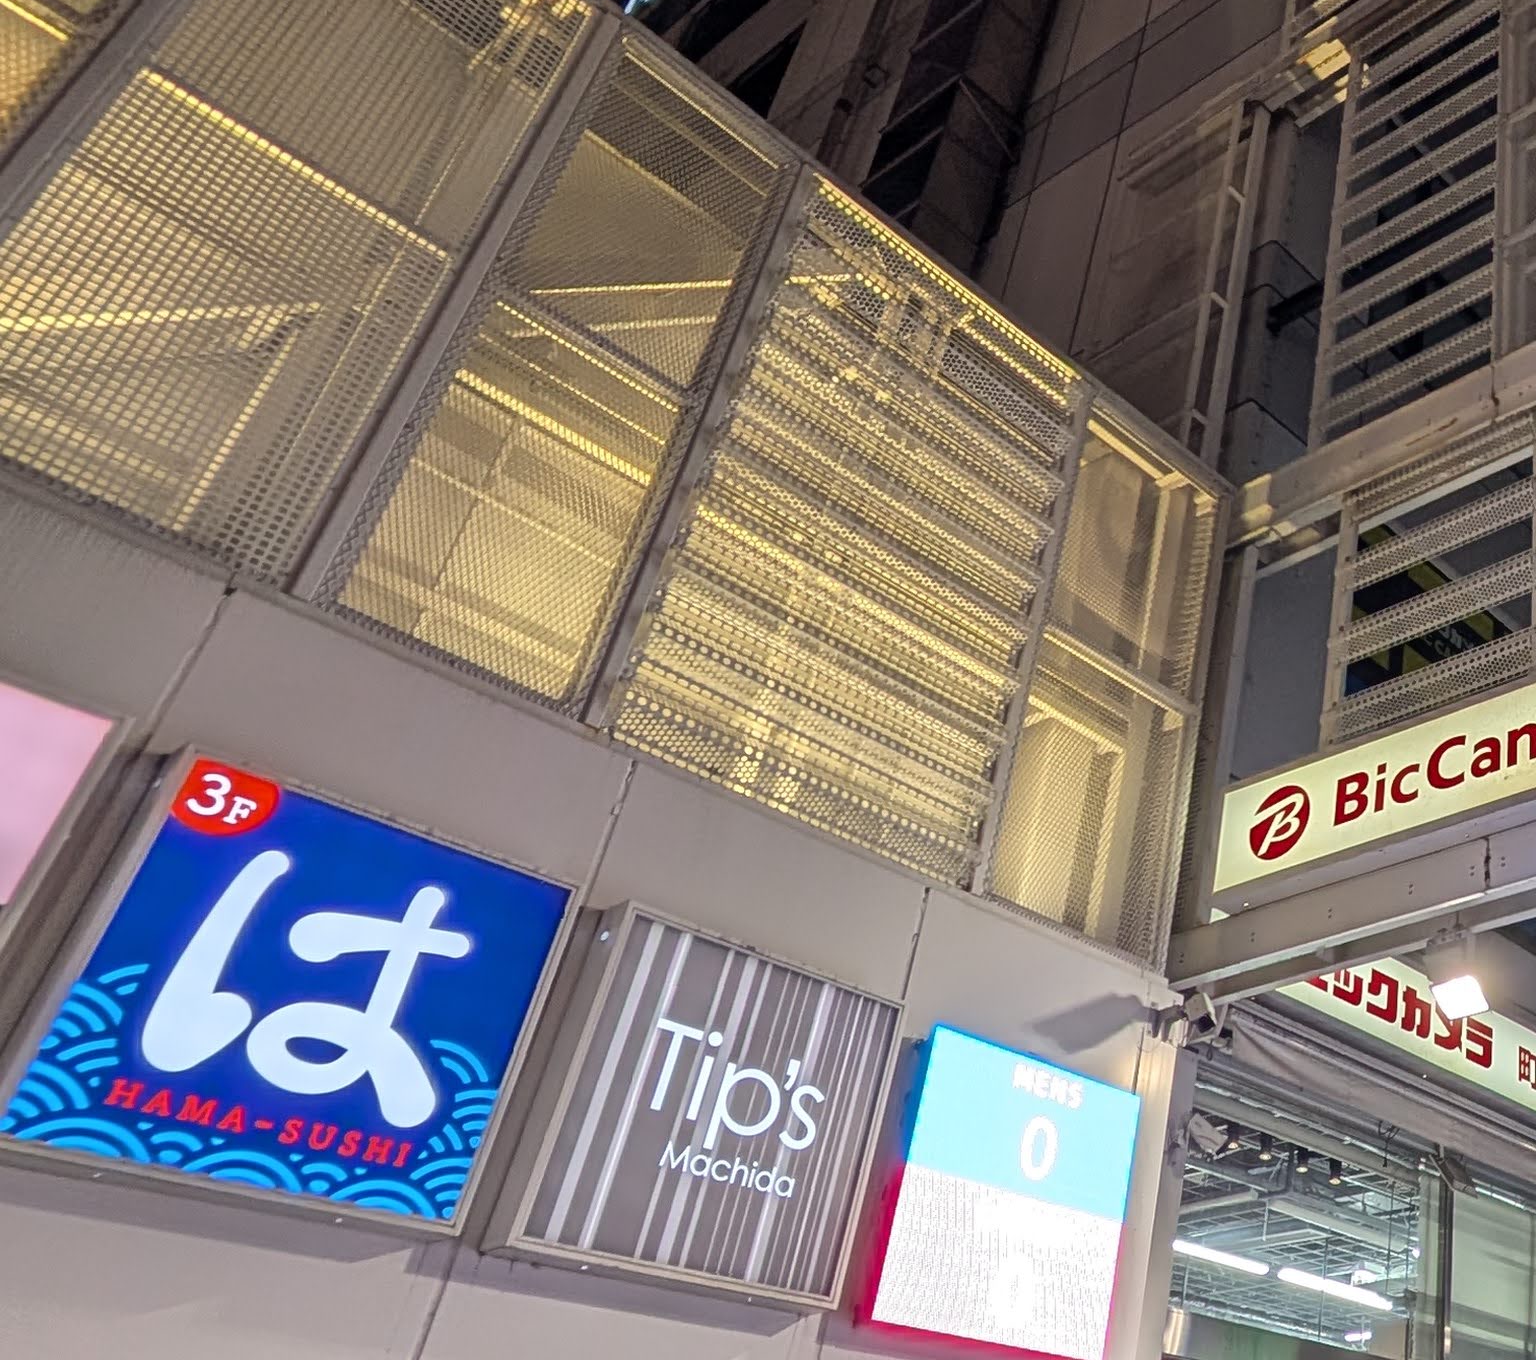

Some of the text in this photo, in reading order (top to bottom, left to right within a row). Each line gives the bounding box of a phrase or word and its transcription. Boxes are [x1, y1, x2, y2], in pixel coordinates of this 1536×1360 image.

[186, 773, 258, 825] 3F
[142, 849, 470, 1129] は
[650, 1018, 825, 1151] Tip's
[1013, 1062, 1083, 1109] MENS
[103, 1079, 414, 1168] HAMA-SUSHI
[1021, 1115, 1058, 1181] 0
[659, 1141, 795, 1198] Machida
